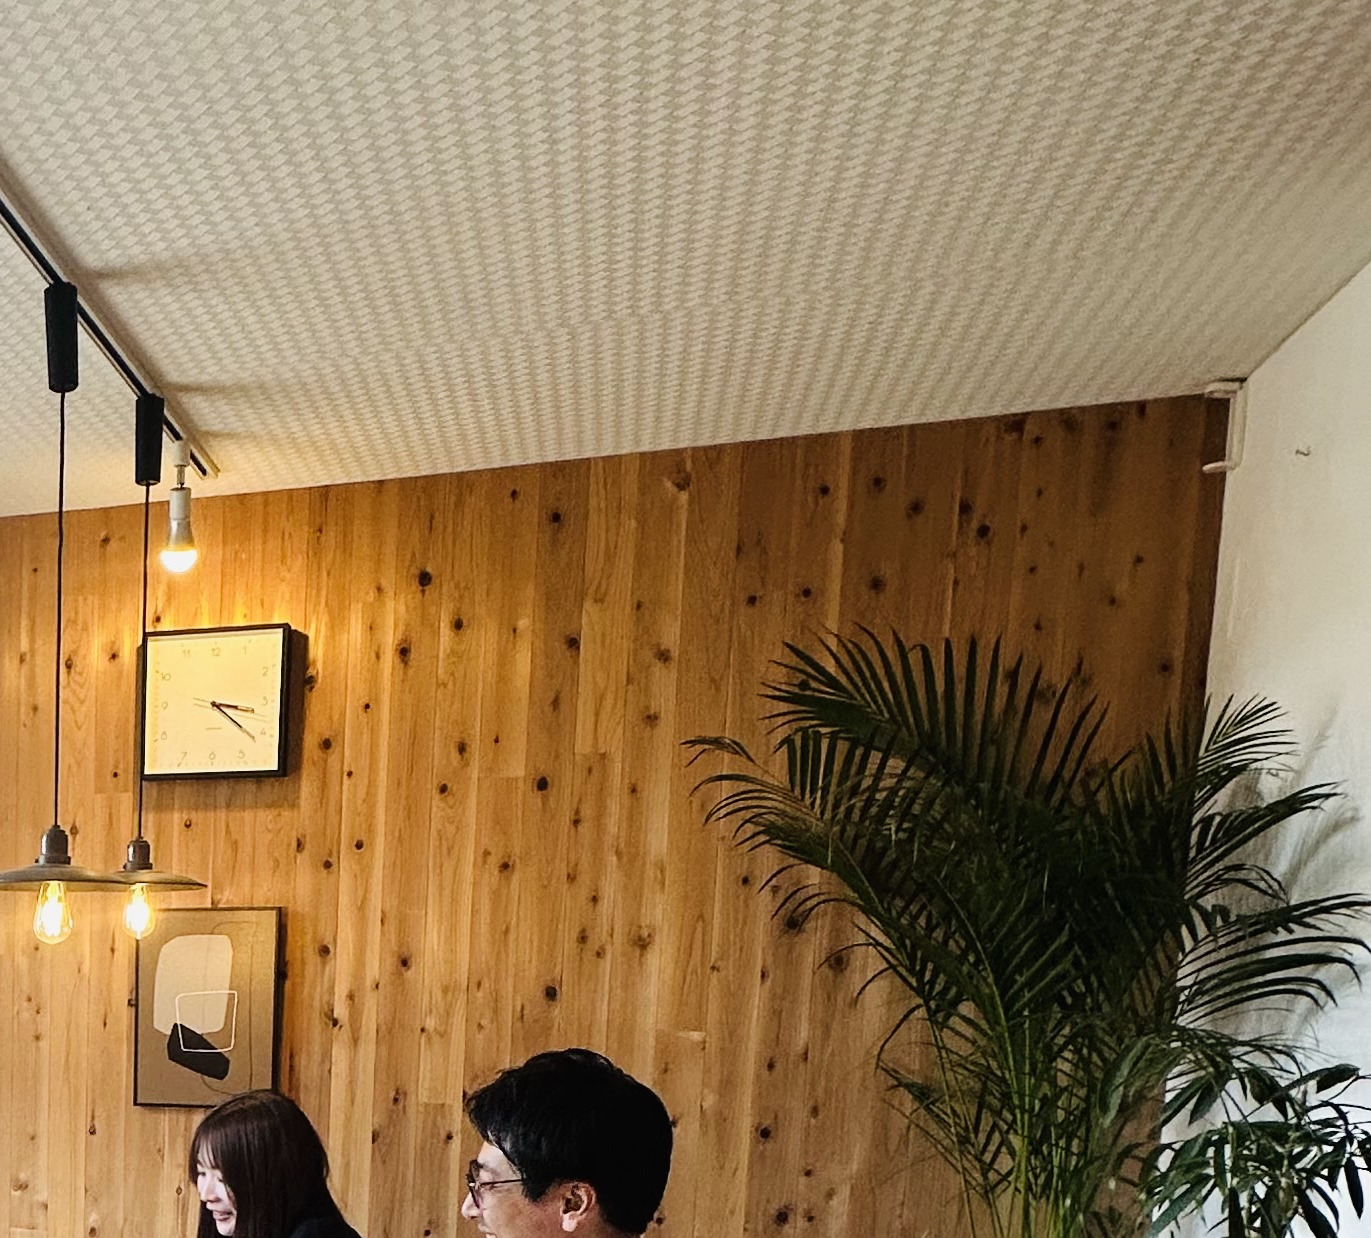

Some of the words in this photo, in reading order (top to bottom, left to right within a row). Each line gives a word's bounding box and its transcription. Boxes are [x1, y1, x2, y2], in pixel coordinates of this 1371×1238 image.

[211, 647, 221, 657] 12
[262, 666, 269, 676] 2
[161, 672, 171, 681] 10
[161, 701, 168, 710] 9
[260, 728, 266, 736] 4
[181, 752, 187, 761] 7
[209, 752, 216, 760] 6
